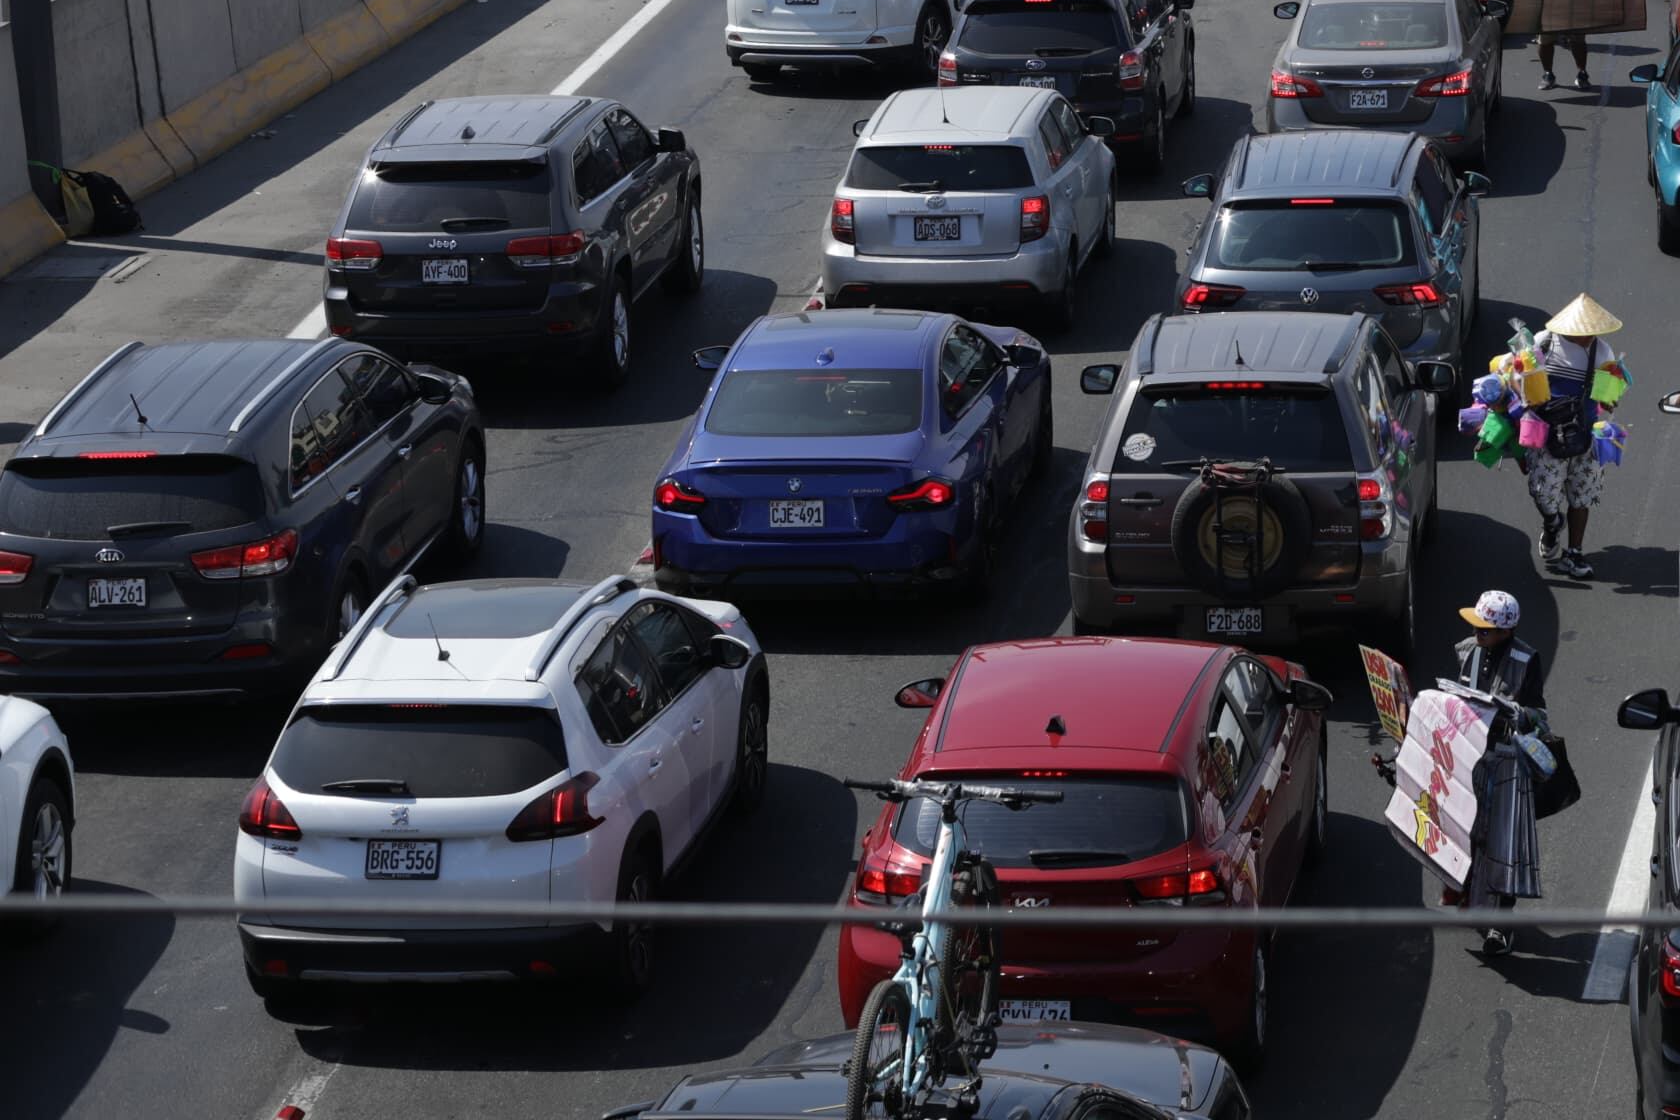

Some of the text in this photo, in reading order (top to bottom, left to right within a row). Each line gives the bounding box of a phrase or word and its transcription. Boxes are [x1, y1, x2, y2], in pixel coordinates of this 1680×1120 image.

[916, 222, 959, 236] ADS-068
[428, 238, 458, 250] Jeep
[771, 507, 822, 524] CJE-491
[99, 552, 120, 562] KIA
[90, 585, 144, 603] ALV-261
[1208, 615, 1261, 630] F2D-688
[1363, 648, 1388, 681] USB
[391, 841, 416, 850] PERU
[370, 850, 434, 870] BRG-556
[1022, 1001, 1048, 1009] PERU
